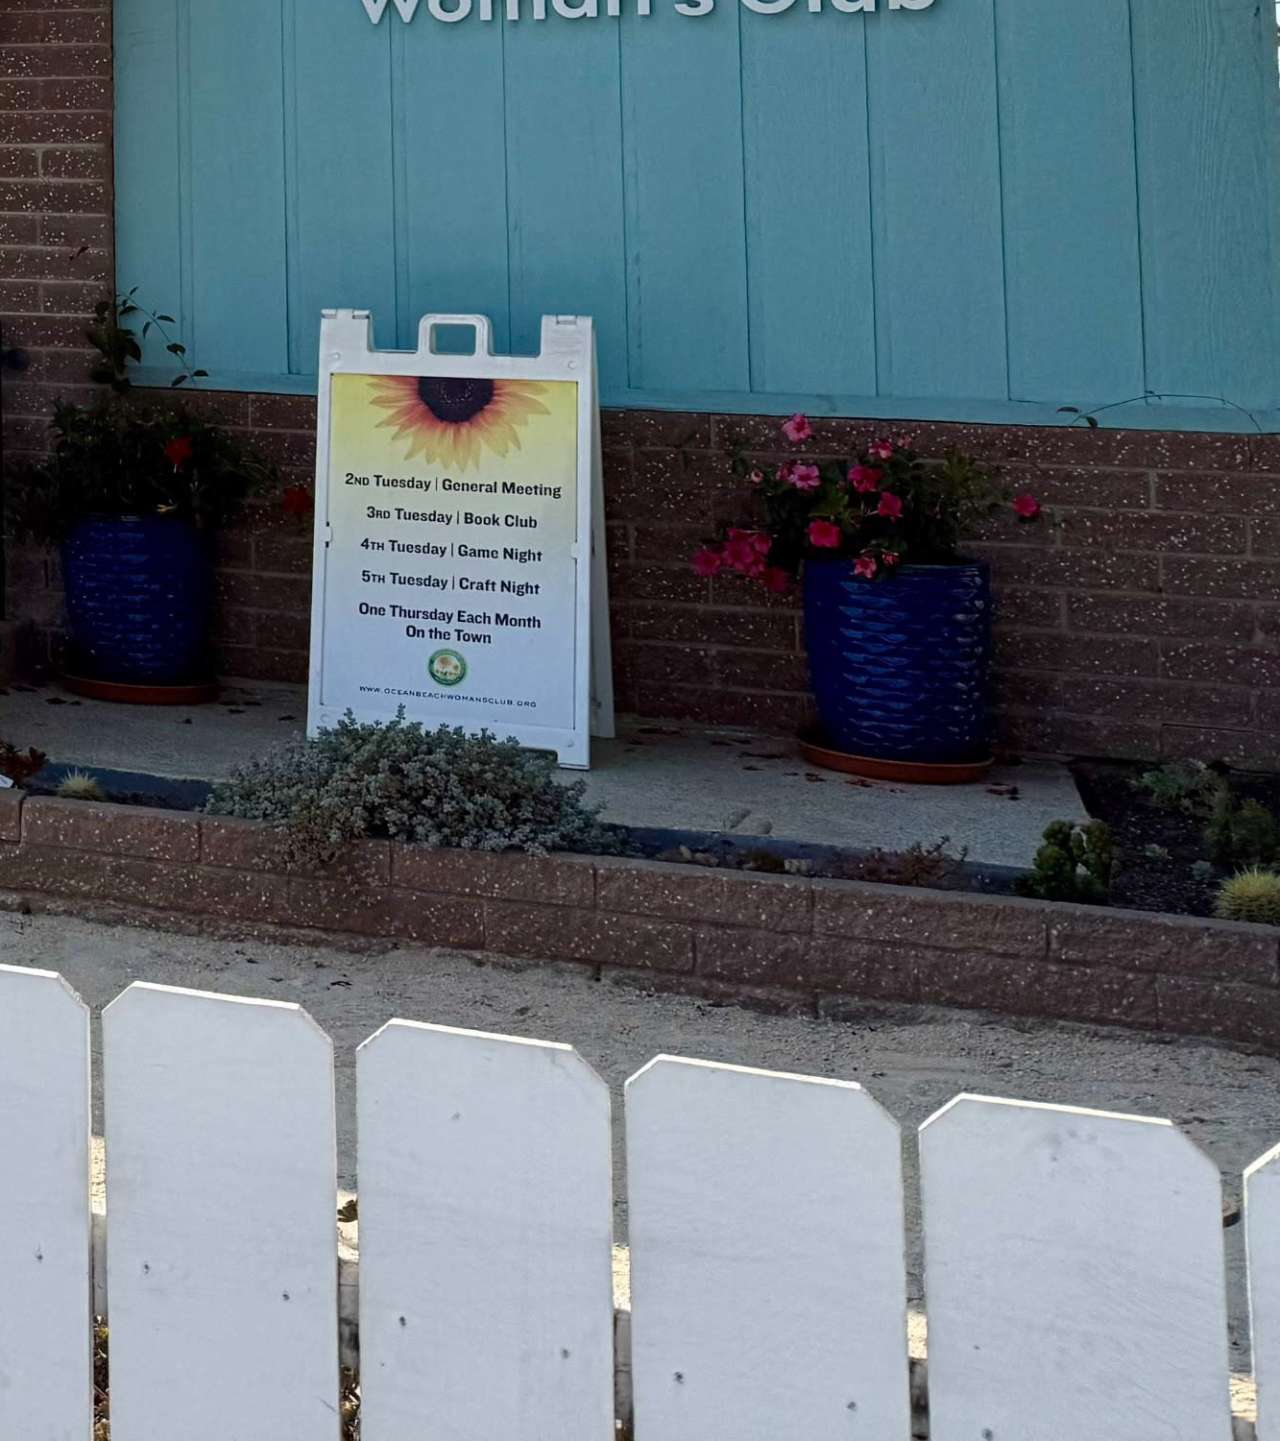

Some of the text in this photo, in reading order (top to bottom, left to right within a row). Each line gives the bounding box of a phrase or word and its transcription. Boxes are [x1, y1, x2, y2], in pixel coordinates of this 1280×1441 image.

[345, 473, 562, 499] 2ND Tuesday General Meeting
[367, 506, 537, 529] 3RD Tuesday Book Club
[361, 538, 542, 563] 4TH Tuesday Game Night
[361, 570, 540, 596] 5TH Tuesday Craft Night
[359, 602, 541, 628] One Thursday Each Month
[406, 625, 491, 644] On the Town
